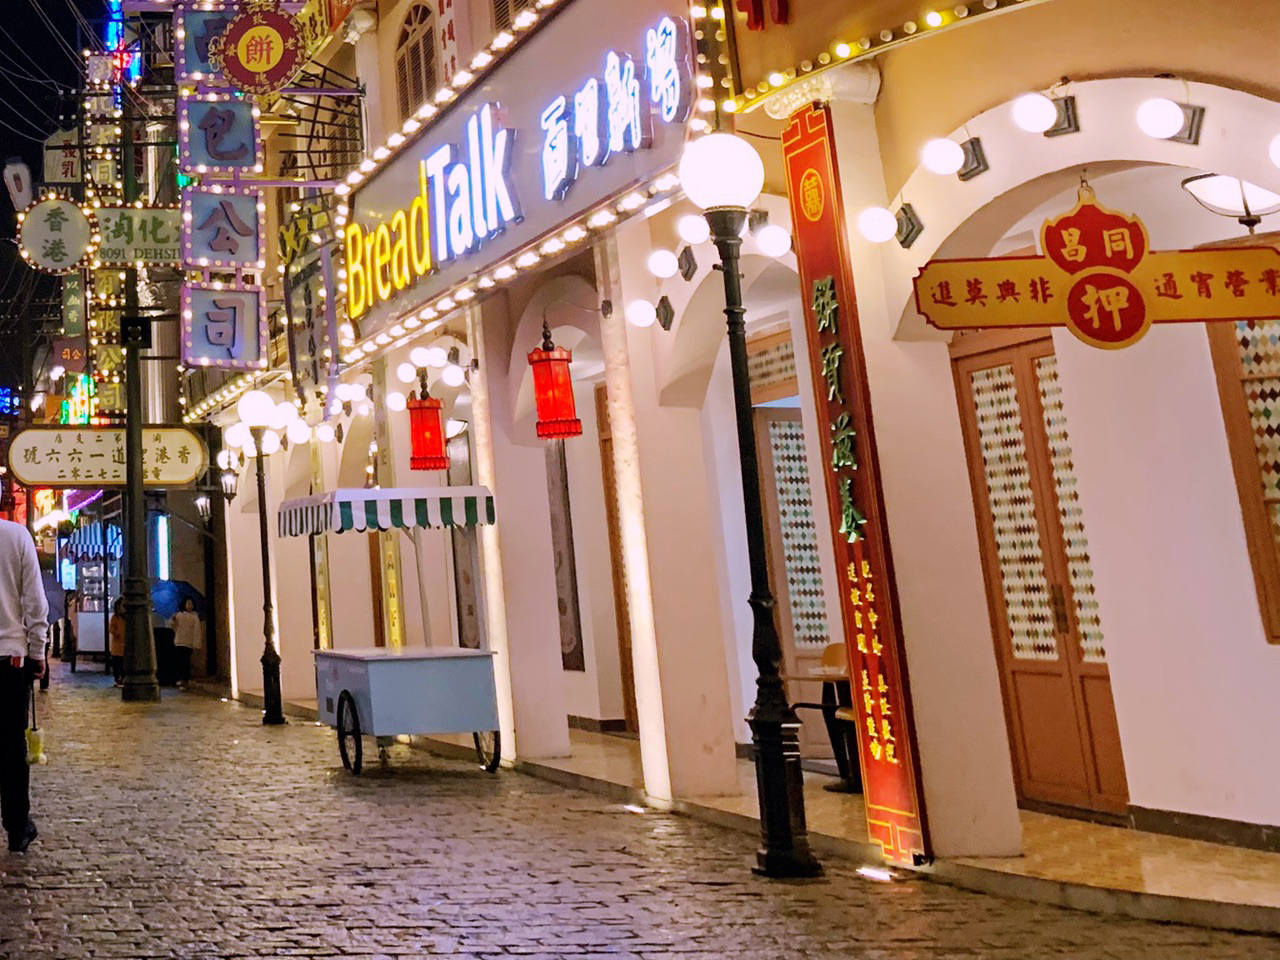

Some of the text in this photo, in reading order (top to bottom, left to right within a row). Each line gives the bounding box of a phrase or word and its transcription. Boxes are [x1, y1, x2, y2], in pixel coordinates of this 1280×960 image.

[245, 33, 274, 66] 餅
[42, 207, 69, 262] 香港
[1081, 283, 1130, 332] 押
